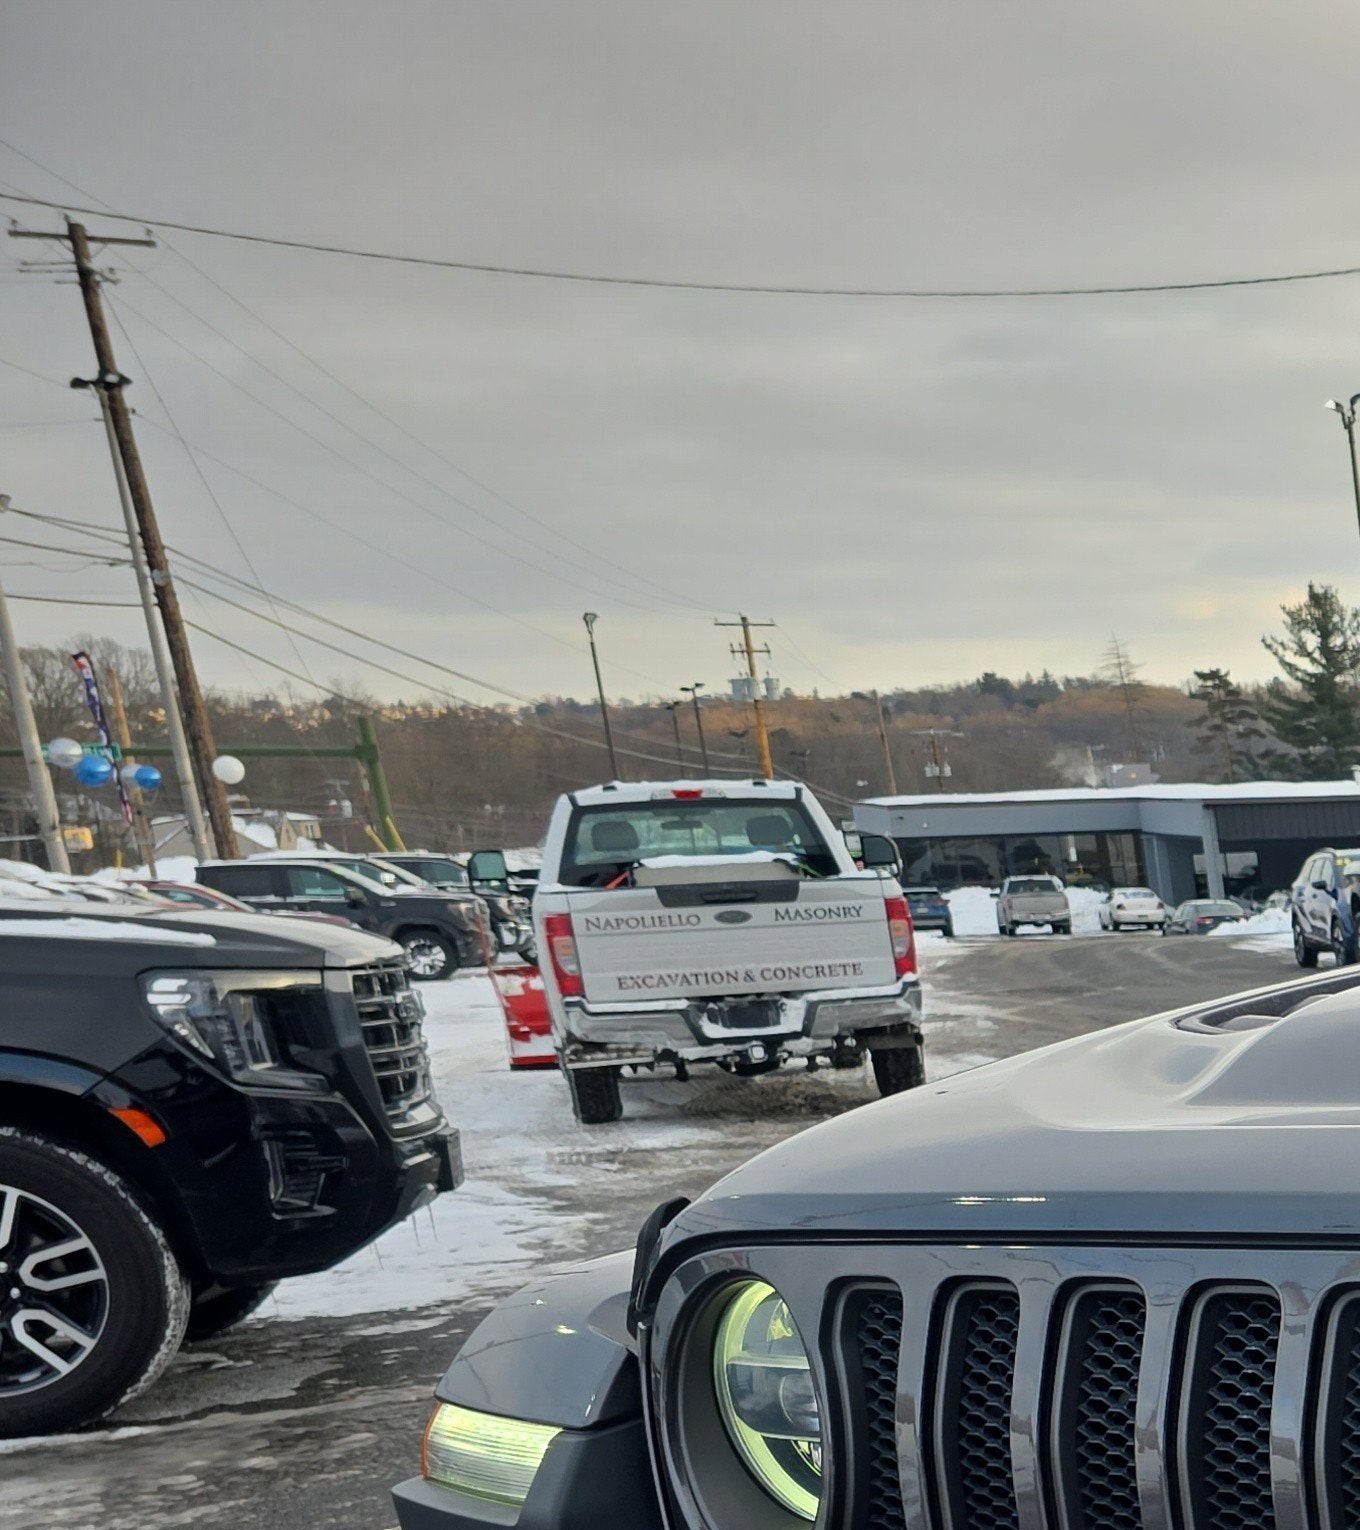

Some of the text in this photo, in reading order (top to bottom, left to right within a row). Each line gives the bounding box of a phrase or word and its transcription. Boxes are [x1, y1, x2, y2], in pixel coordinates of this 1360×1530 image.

[585, 913, 701, 932] NAPOLIELLO
[774, 905, 863, 922] MASONRY
[616, 962, 864, 991] EXCAVATION & CONCRETE
